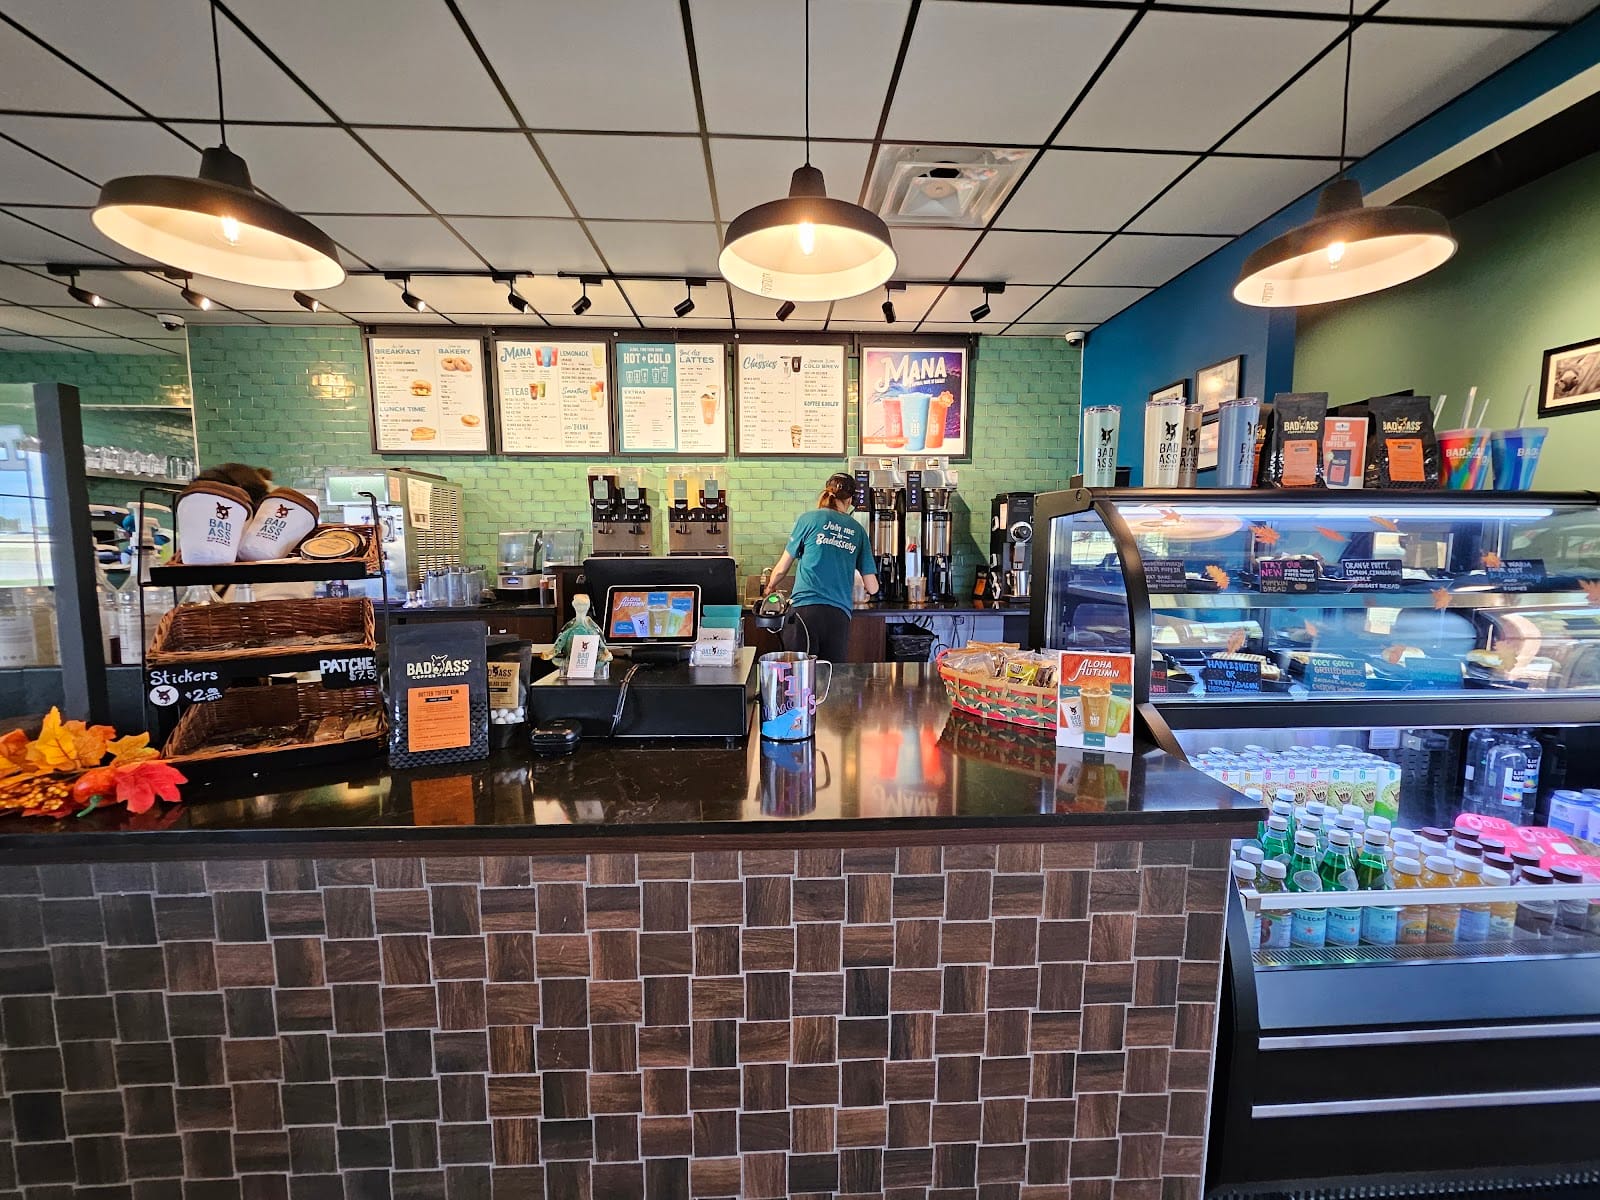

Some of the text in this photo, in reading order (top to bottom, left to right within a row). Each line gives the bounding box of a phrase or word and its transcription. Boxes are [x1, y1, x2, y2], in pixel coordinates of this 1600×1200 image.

[501, 347, 532, 362] MANA
[624, 353, 671, 364] HOT COLD
[679, 356, 715, 364] LATTES
[743, 356, 778, 369] Classics
[874, 355, 947, 392] MANA
[510, 388, 529, 396] TEAS
[1284, 421, 1319, 431] BAD ASS
[1406, 421, 1420, 430] ASS
[1097, 447, 1114, 458] BAD
[1159, 443, 1179, 453] BAD
[1181, 447, 1199, 457] BAD
[1445, 447, 1466, 458] BAD
[1097, 458, 1113, 468] ASS
[1158, 453, 1178, 464] ASS
[209, 518, 232, 532] BAD
[264, 517, 287, 529] BAD
[822, 520, 855, 536] Join me
[208, 527, 231, 541] ASS
[259, 525, 283, 536] ASS
[1262, 561, 1282, 569] TRY
[1261, 569, 1282, 577] NEW
[407, 660, 469, 676] BAD ASS
[1079, 659, 1112, 669] ALOHA
[150, 669, 218, 685] Stickers
[349, 669, 377, 681] $7.5
[498, 669, 512, 677] ASS
[1068, 668, 1120, 681] AUTUMN
[1226, 670, 1236, 679] OR
